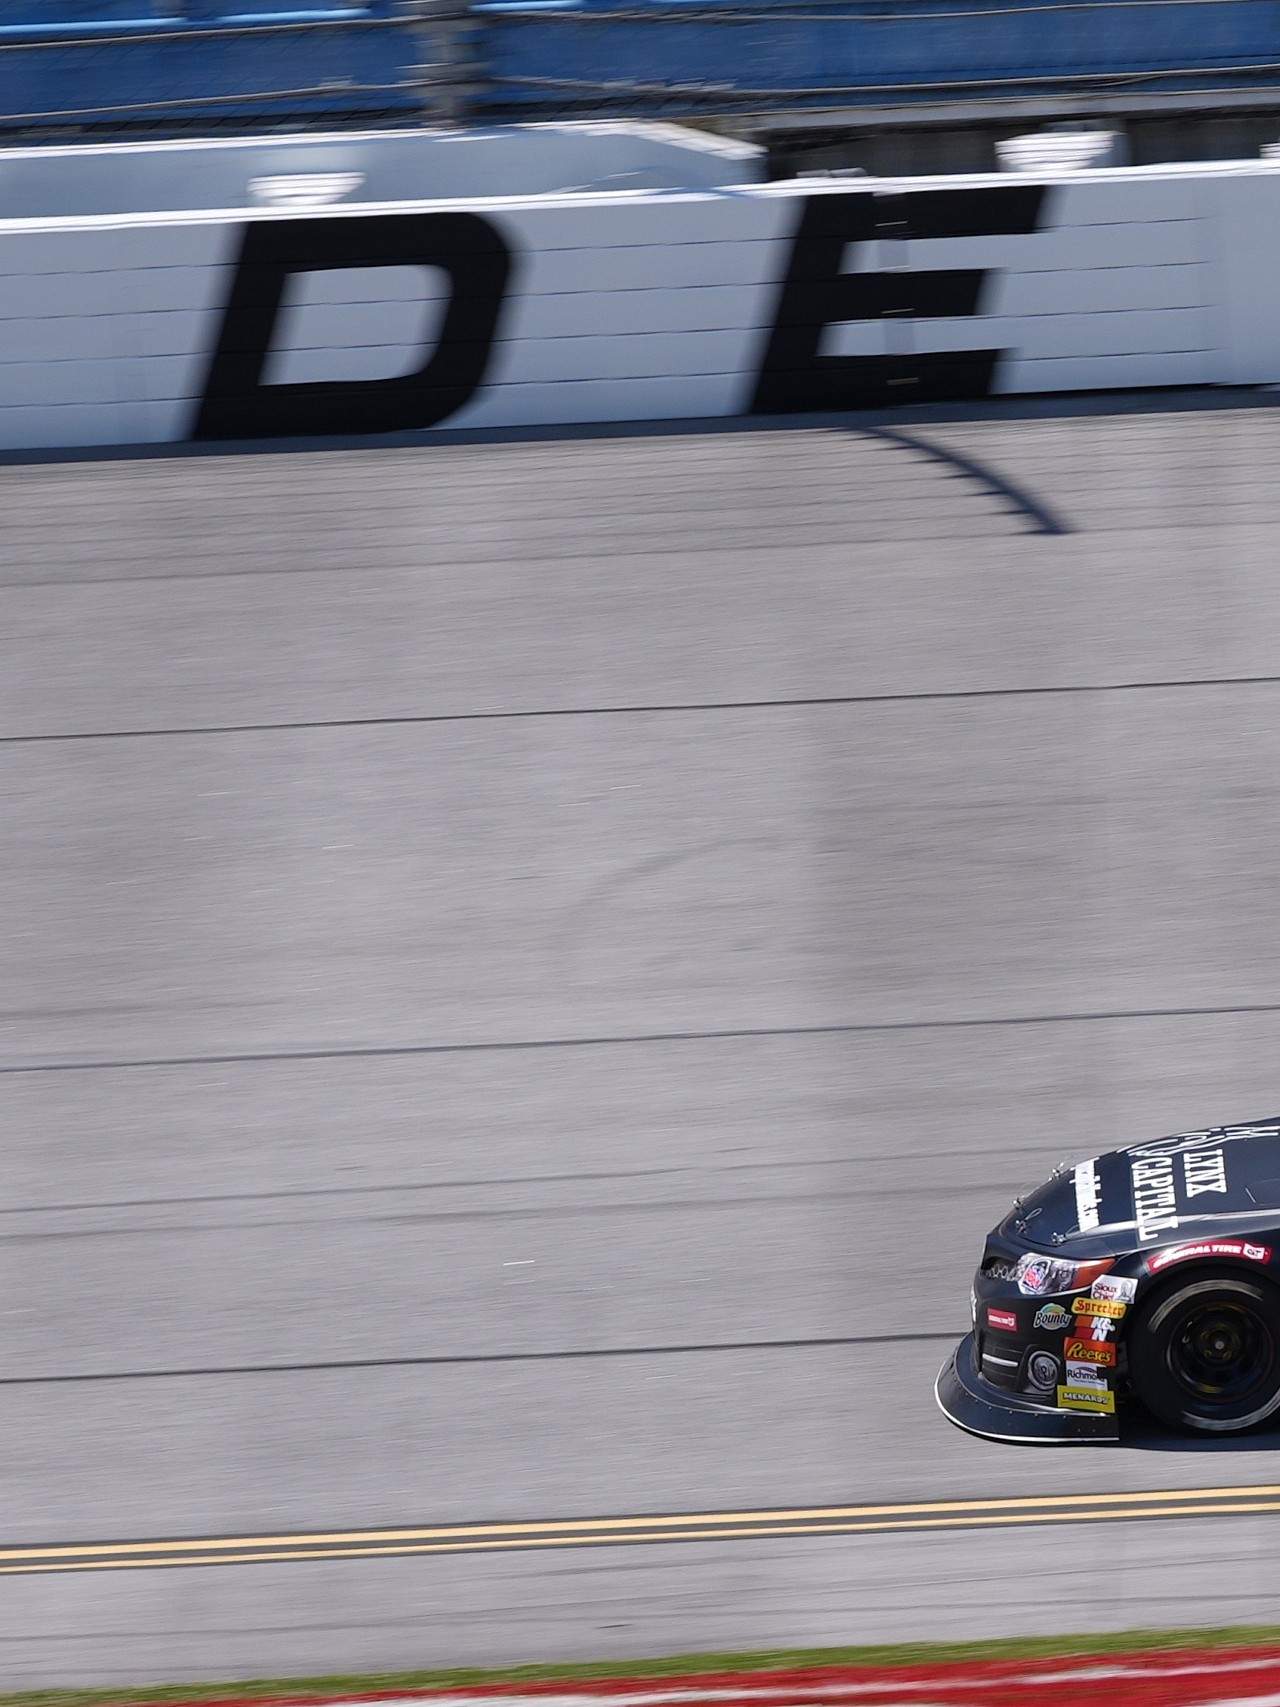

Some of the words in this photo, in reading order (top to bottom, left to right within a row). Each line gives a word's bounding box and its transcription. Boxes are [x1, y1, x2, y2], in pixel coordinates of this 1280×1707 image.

[1183, 1148, 1227, 1198] LYNX
[1131, 1157, 1179, 1241] CAPITAL
[1211, 1244, 1242, 1254] TIRE
[1094, 1282, 1117, 1292] Sioux
[1075, 1299, 1125, 1317] Sprecher
[1034, 1310, 1072, 1329] Bounty
[1066, 1342, 1112, 1363] Reese's
[1067, 1368, 1106, 1383] Richmod
[1063, 1391, 1109, 1404] MENARDS
